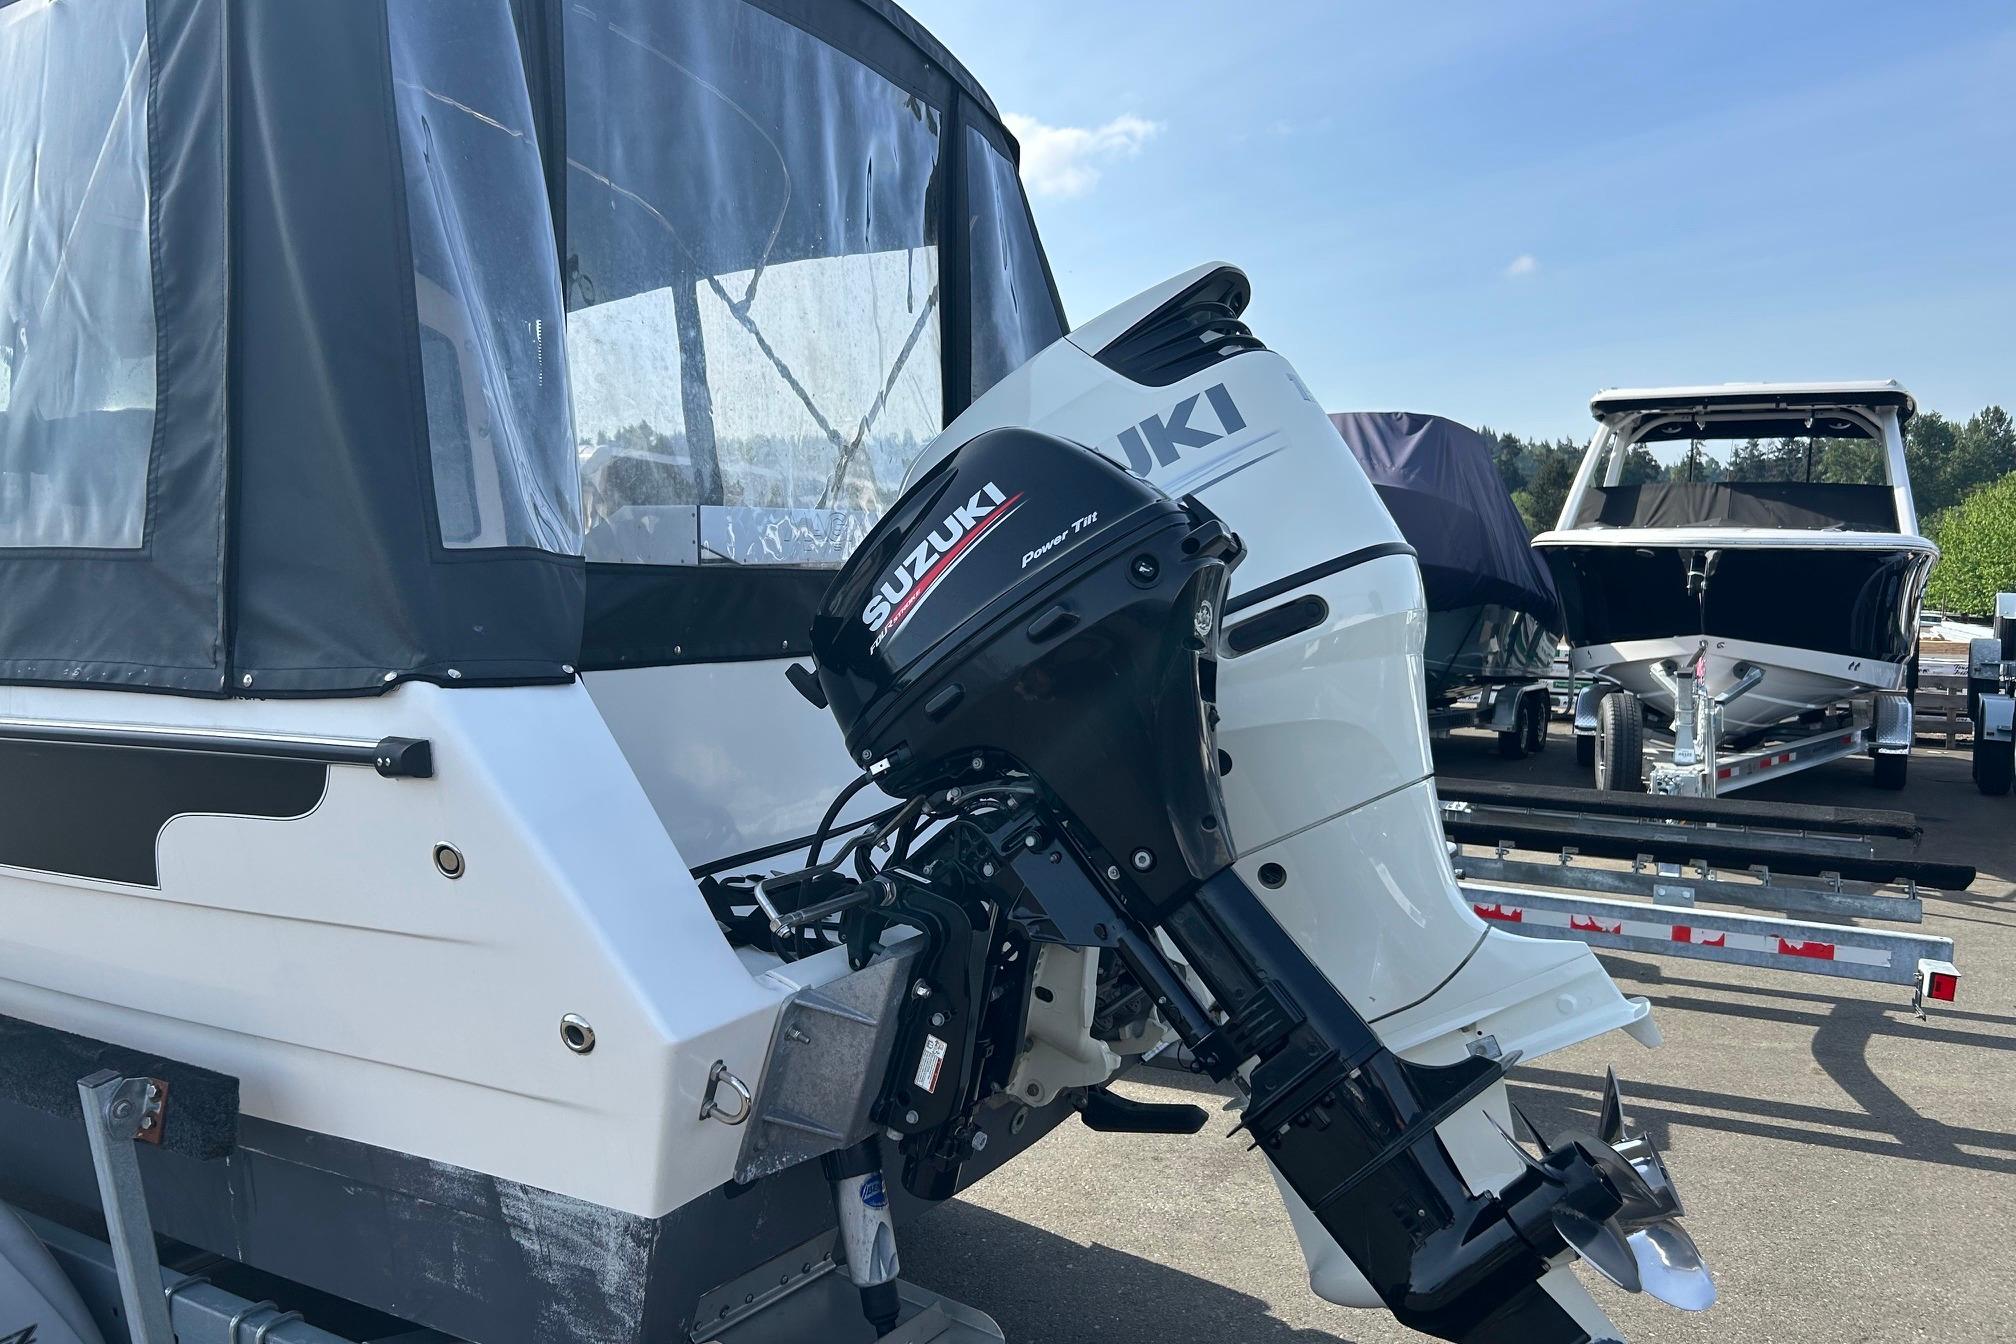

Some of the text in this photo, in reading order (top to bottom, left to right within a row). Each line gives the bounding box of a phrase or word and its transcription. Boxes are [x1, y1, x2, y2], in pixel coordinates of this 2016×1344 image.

[862, 481, 1007, 632] SUZUKI
[1021, 511, 1098, 569] Power Tilt
